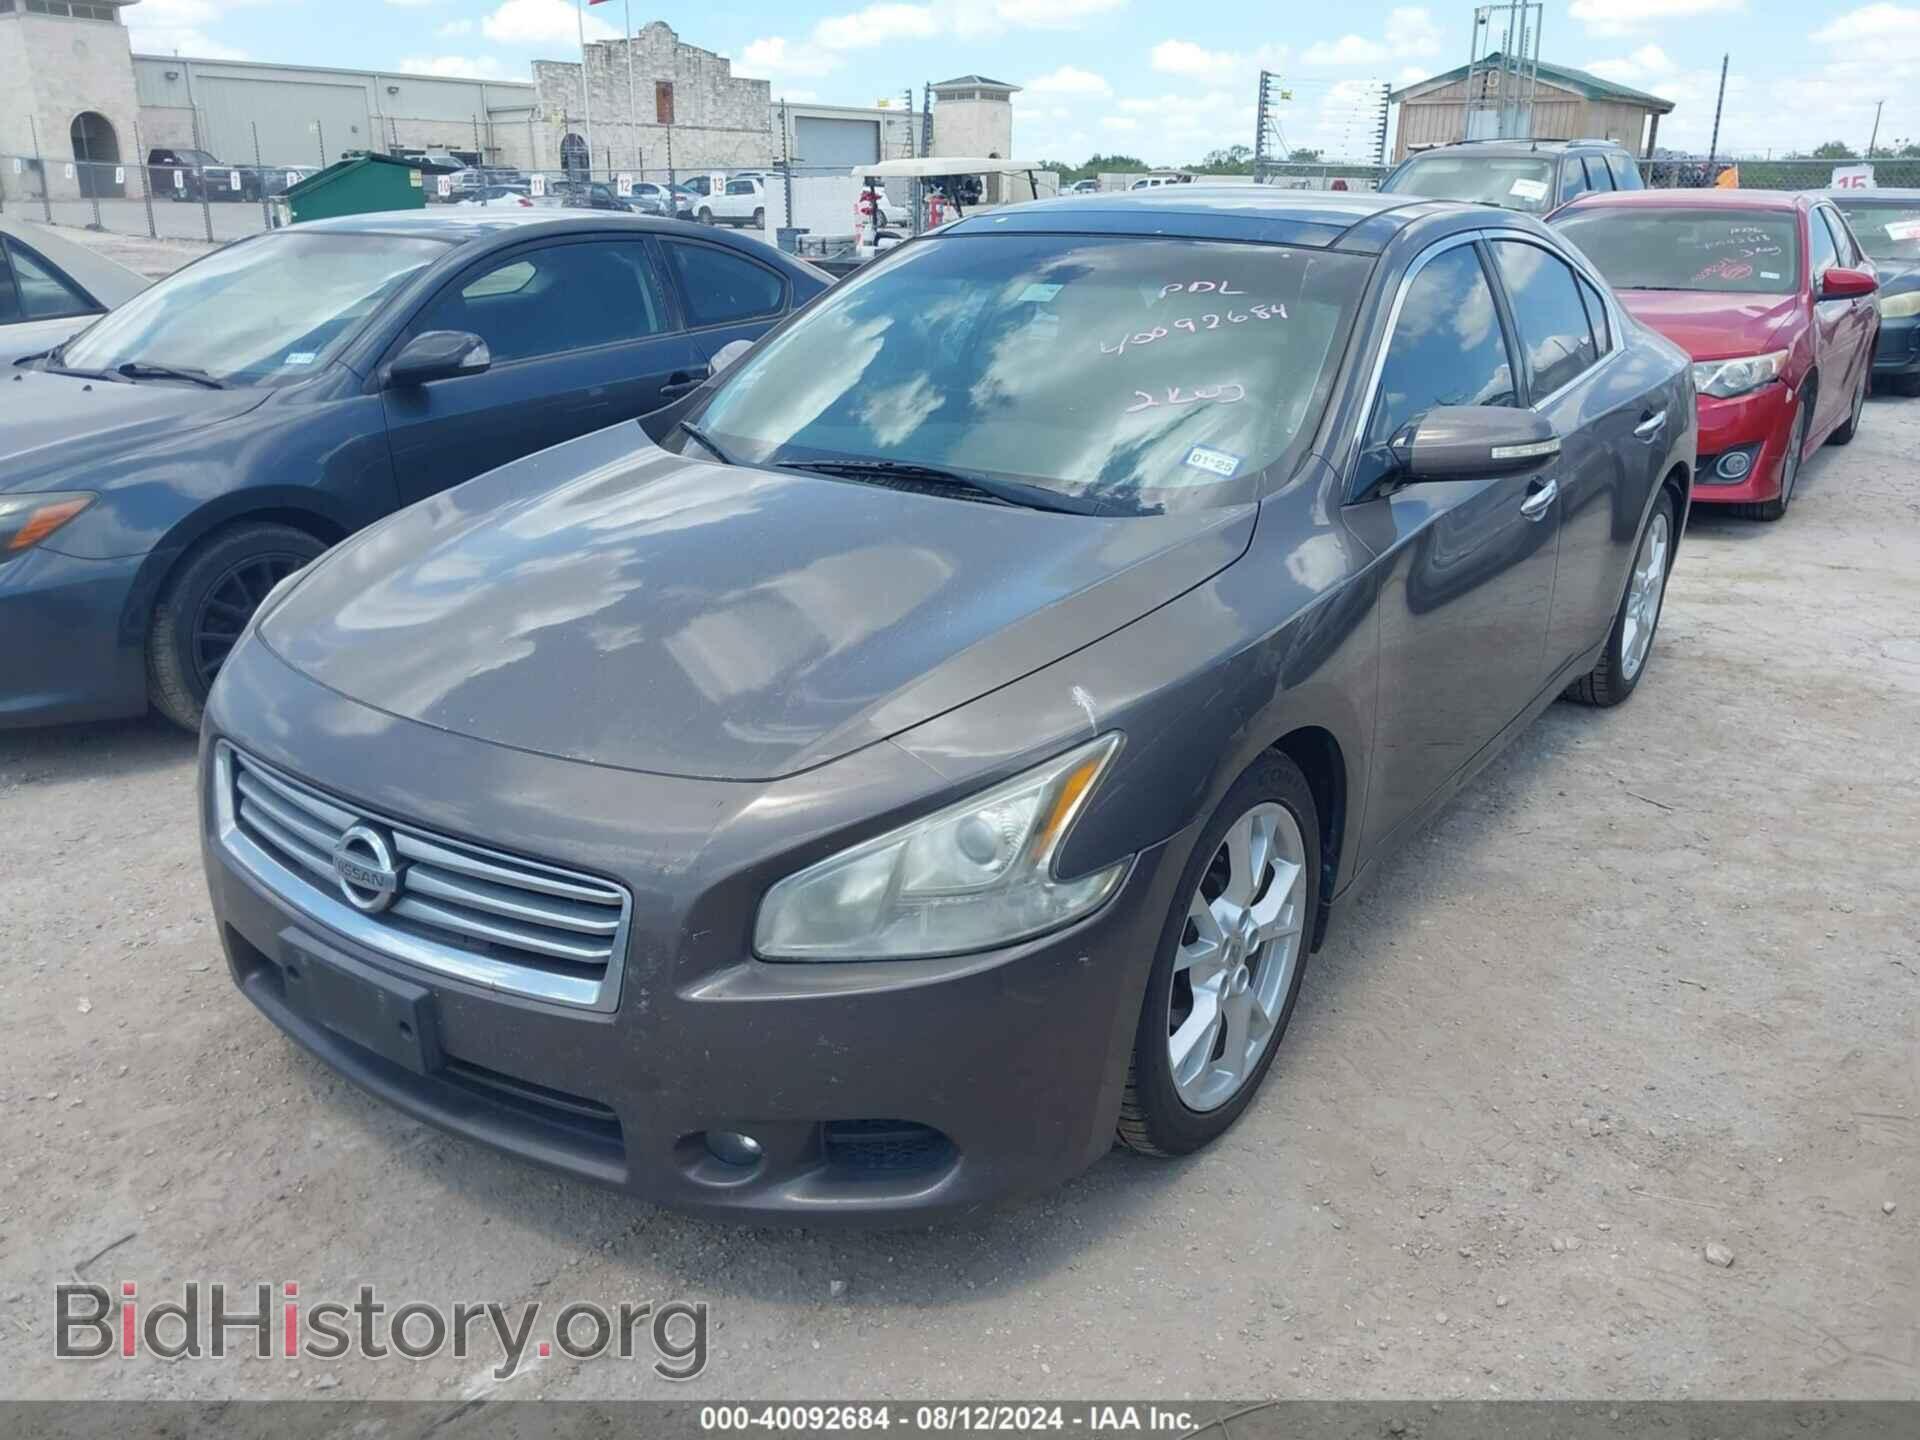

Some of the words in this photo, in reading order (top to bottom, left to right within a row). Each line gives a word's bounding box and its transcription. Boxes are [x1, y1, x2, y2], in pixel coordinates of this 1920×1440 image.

[619, 178, 631, 193] 12
[713, 176, 725, 192] 13
[1838, 175, 1868, 188] 15
[1100, 304, 1288, 354] 40092684
[334, 855, 385, 887] NISSAN
